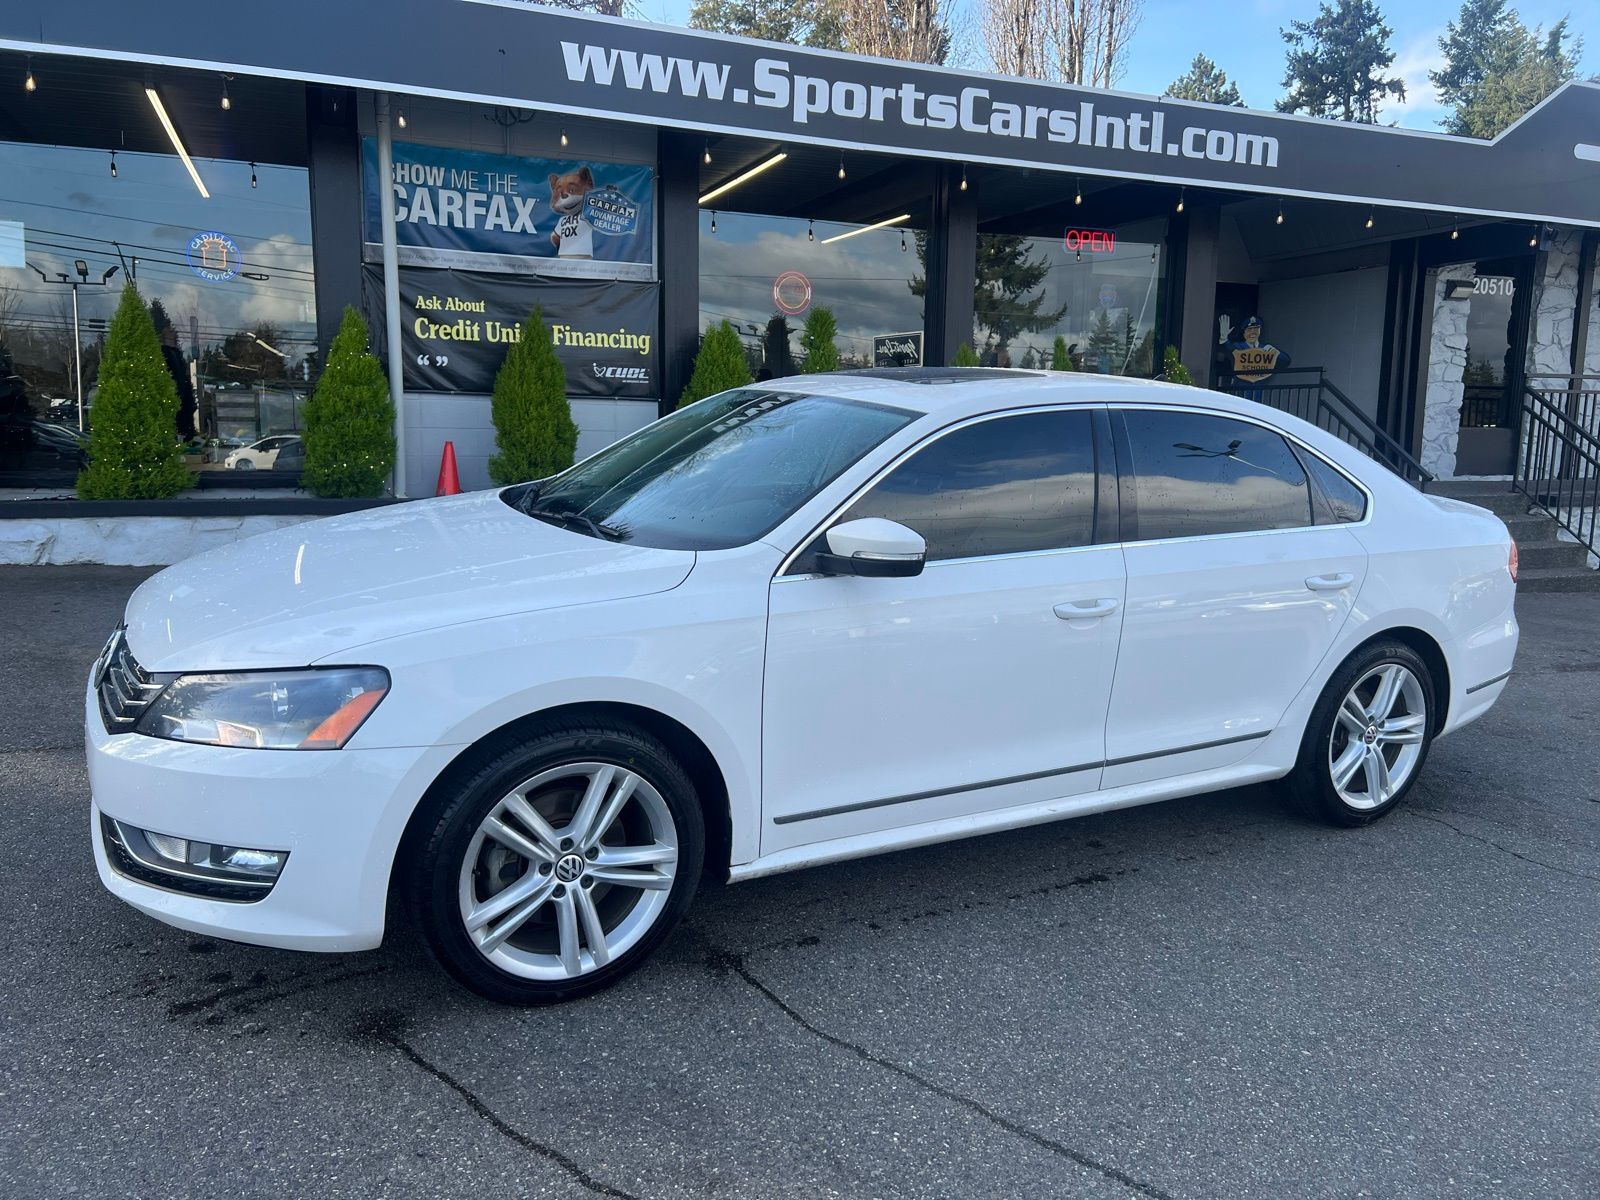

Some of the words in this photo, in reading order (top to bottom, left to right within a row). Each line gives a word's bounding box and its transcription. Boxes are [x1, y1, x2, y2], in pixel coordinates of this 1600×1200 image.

[560, 41, 1279, 168] www.SportsCarsIntl.com
[451, 168, 478, 191] ME
[484, 172, 518, 195] THE
[393, 184, 538, 235] CARFAX
[588, 197, 635, 218] CARFAX
[590, 209, 630, 226] ADVANTAGE
[561, 225, 578, 239] FOX
[593, 219, 621, 233] DEALER
[1066, 230, 1115, 252] OPEN
[1473, 277, 1514, 296] 20510
[415, 295, 442, 310] Ask
[445, 297, 485, 313] About
[414, 317, 480, 341] Credit
[485, 321, 524, 343] Uni
[552, 325, 651, 355] Financing
[1240, 353, 1274, 364] SLOW
